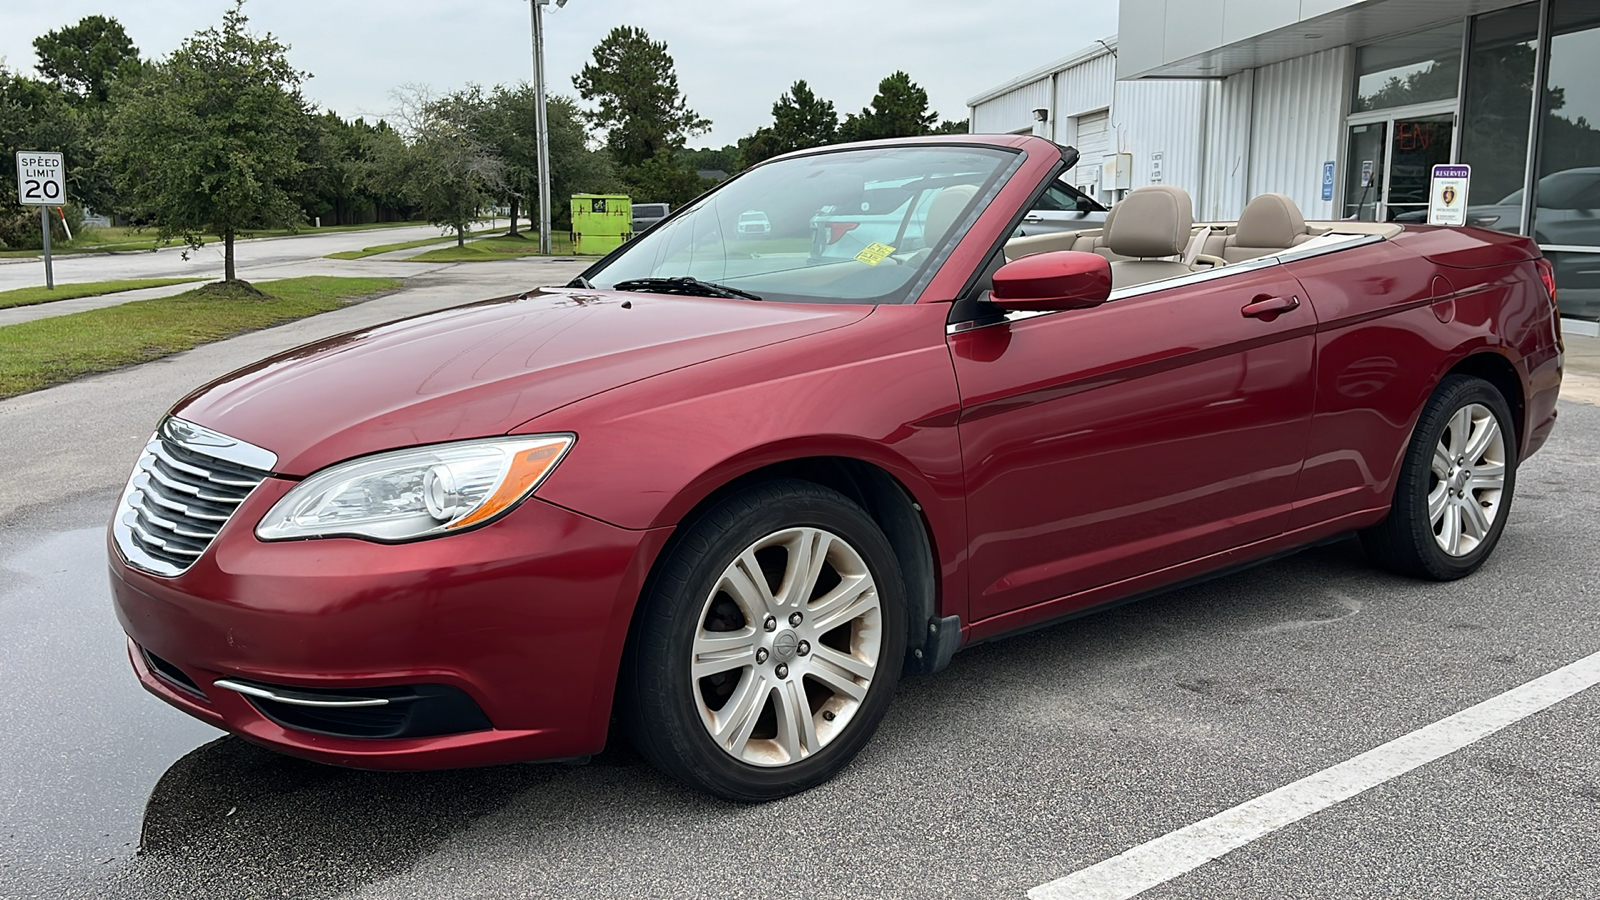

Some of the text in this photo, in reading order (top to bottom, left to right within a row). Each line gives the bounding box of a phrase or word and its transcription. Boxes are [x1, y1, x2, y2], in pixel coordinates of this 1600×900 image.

[21, 158, 59, 167] SPEED
[26, 169, 55, 177] LIMIT
[25, 180, 60, 199] 20
